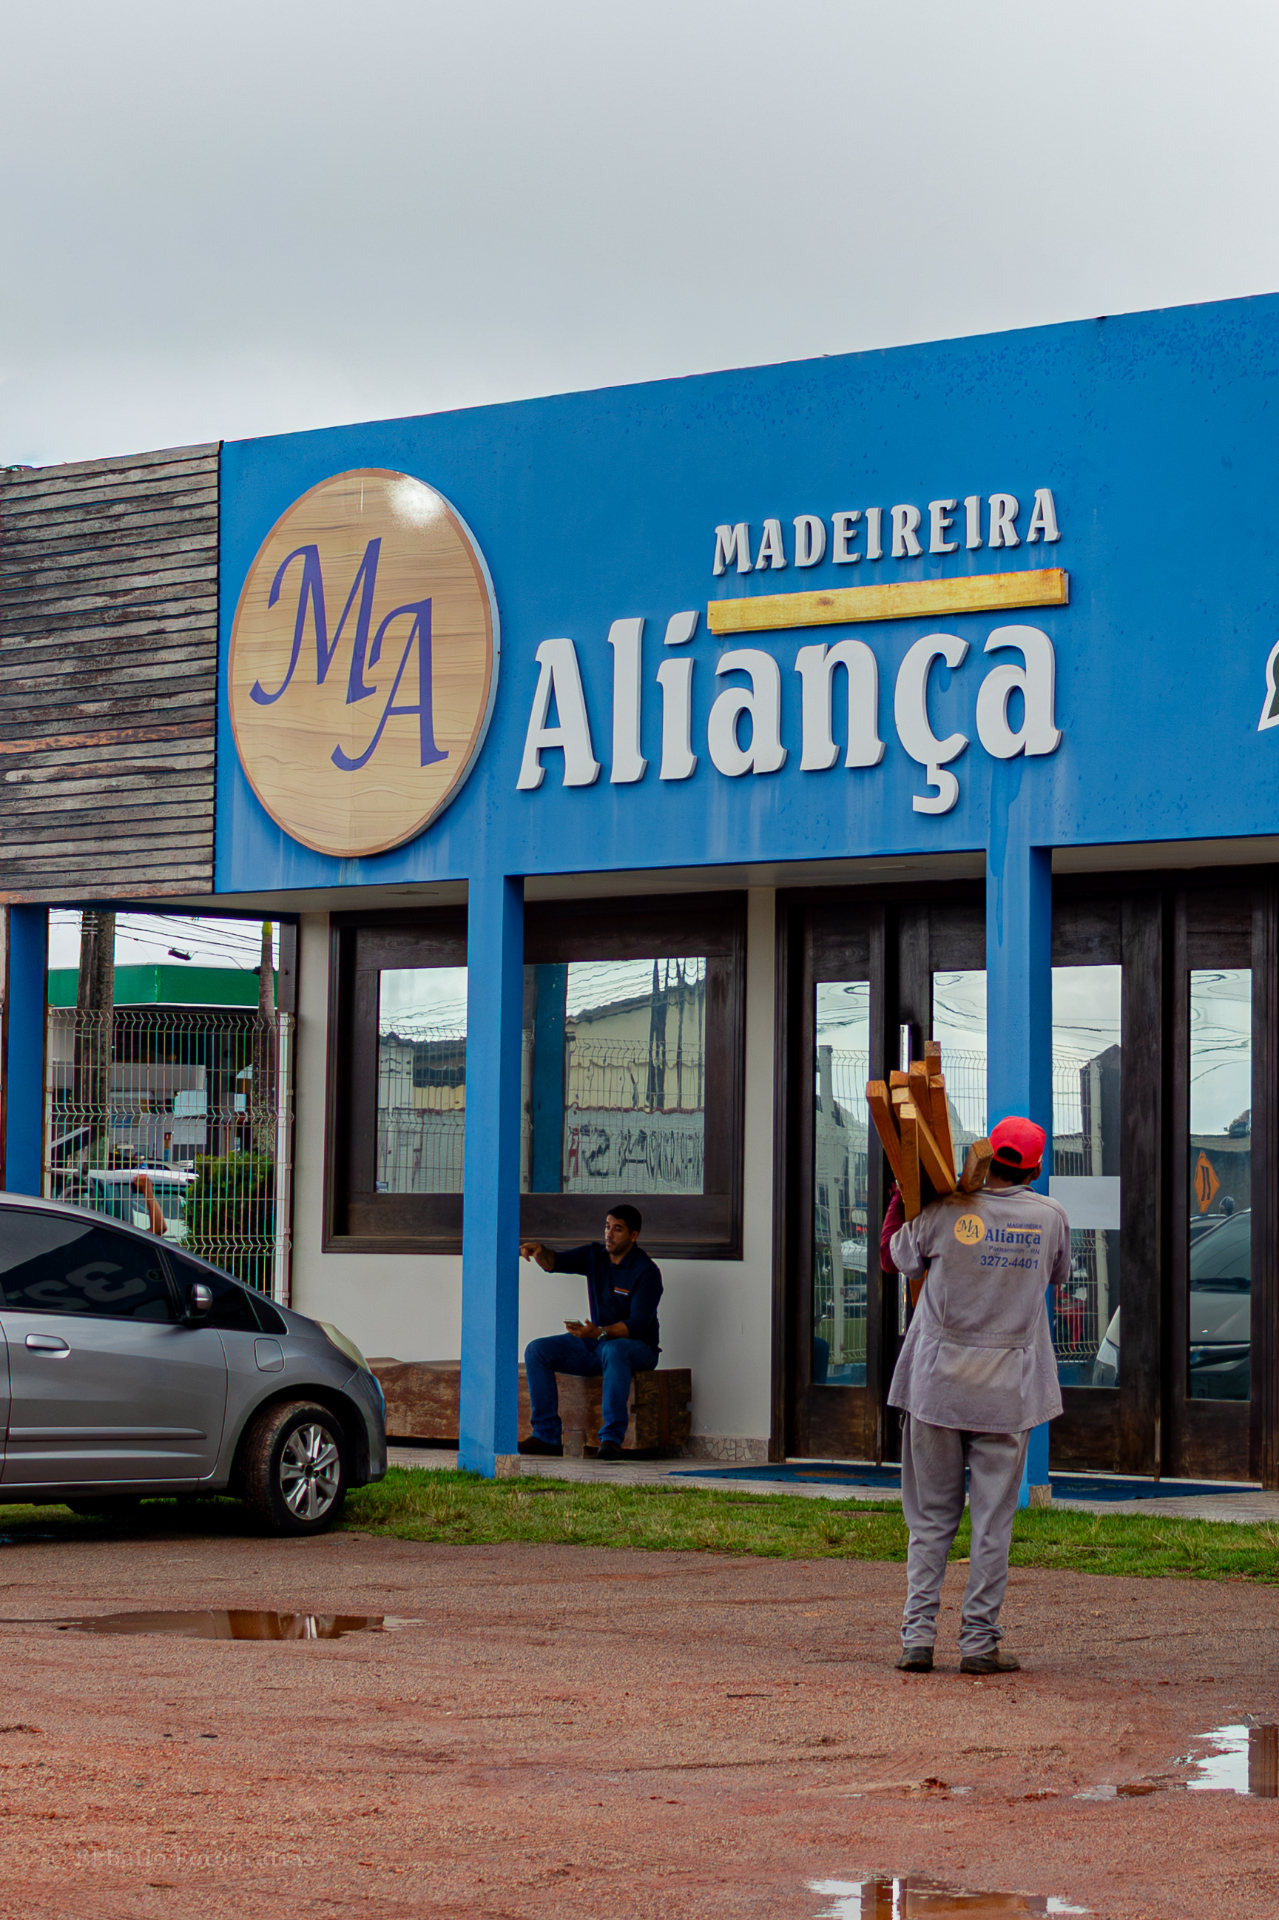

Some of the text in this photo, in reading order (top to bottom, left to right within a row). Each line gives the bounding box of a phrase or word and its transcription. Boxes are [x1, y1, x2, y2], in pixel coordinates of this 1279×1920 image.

[712, 488, 1062, 575] MADEIREIRA
[516, 610, 1062, 814] Aliança
[980, 1255, 1039, 1270] 3272-4401
[985, 1229, 1041, 1248] Aliança
